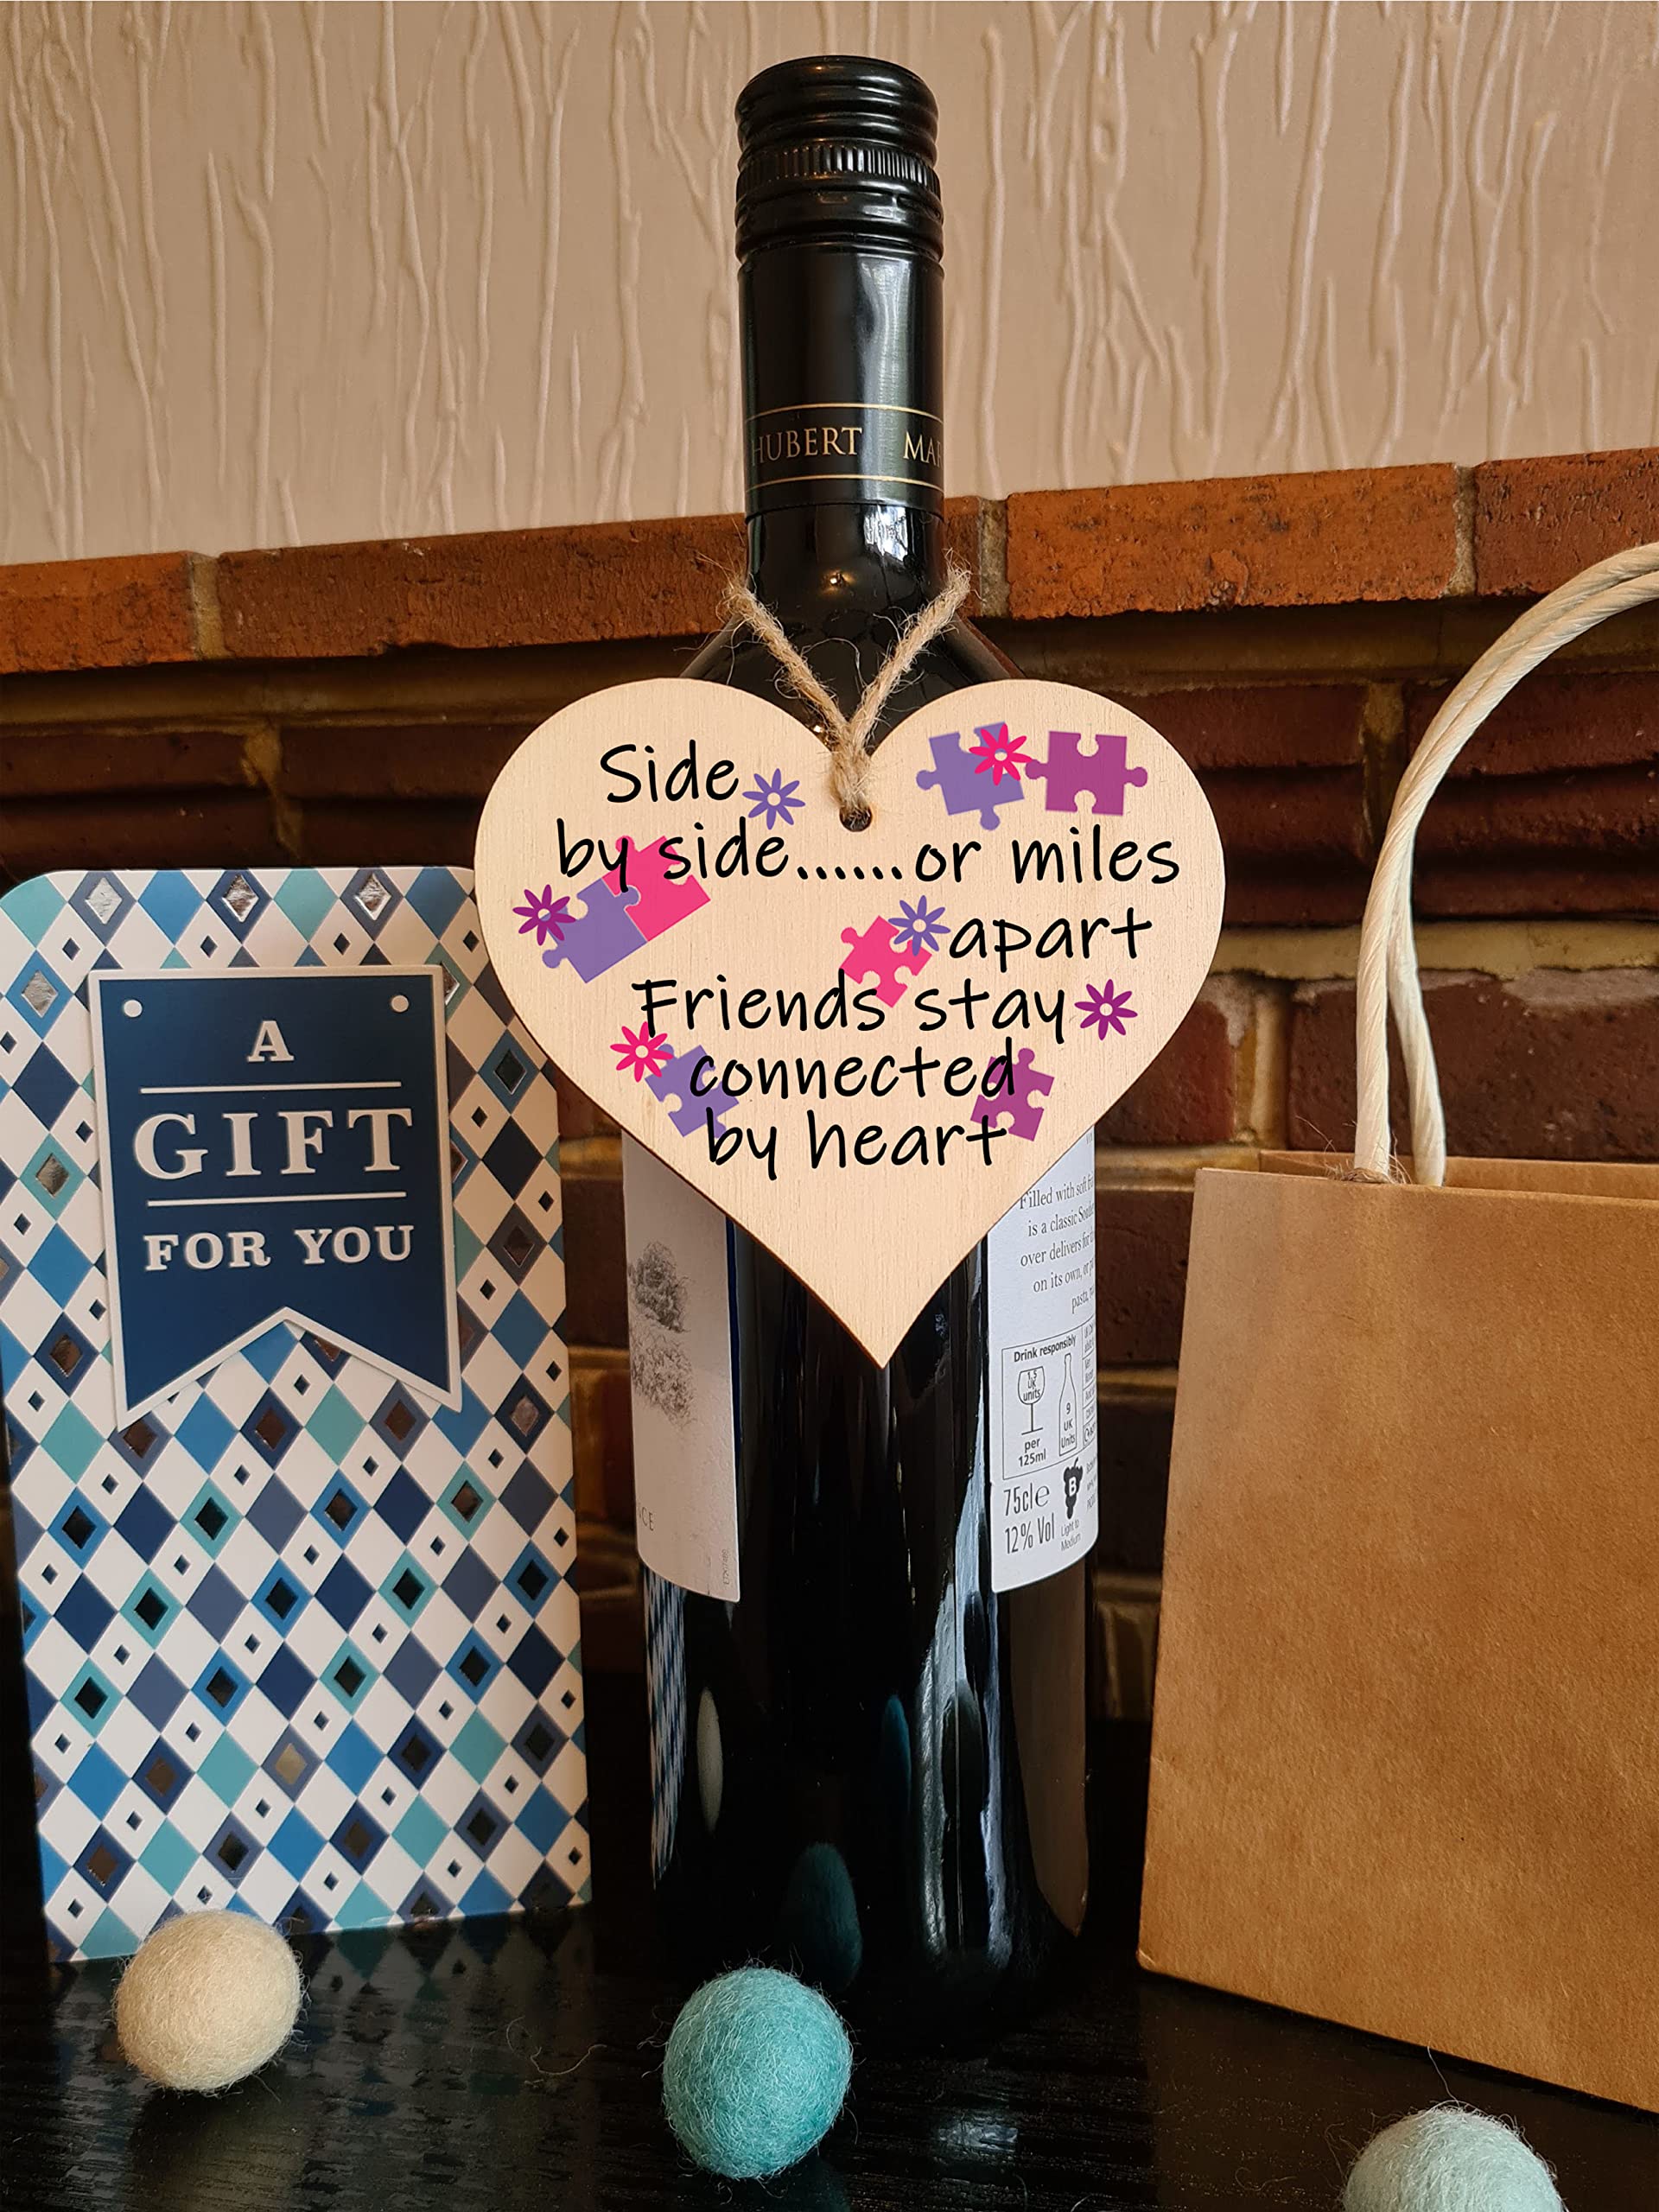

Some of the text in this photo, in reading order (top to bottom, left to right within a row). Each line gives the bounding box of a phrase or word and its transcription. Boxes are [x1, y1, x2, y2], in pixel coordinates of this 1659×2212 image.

[752, 427, 862, 467] HUBERT
[601, 740, 739, 803] Side
[557, 818, 629, 893] by
[1013, 823, 1179, 885] miles
[949, 908, 1153, 973] apart
[632, 969, 1065, 1045] Friends stay
[246, 1020, 295, 1063] A
[690, 1037, 1015, 1101] connected
[134, 1108, 413, 1179] GIFT
[705, 1107, 1007, 1181] by heart
[1056, 1182, 1075, 1202] with
[1028, 1219, 1038, 1236] is
[1041, 1223, 1047, 1234] a
[1050, 1210, 1077, 1232] classic
[143, 1225, 414, 1271] FOR YOU
[1020, 1250, 1046, 1267] over
[1049, 1240, 1082, 1261] delivers
[1033, 1279, 1047, 1293] on
[1051, 1271, 1063, 1288] its
[1014, 1347, 1037, 1363] Drink
[1039, 1334, 1077, 1356] responsibly
[1023, 1389, 1041, 1401] units
[1027, 1377, 1037, 1389] UK
[1065, 1402, 1071, 1414] 9
[1064, 1419, 1073, 1431] UK
[1025, 1438, 1040, 1453] per
[1061, 1433, 1076, 1448] Units
[1018, 1448, 1046, 1467] 125ml
[1069, 1476, 1077, 1497] B
[1005, 1512, 1054, 1554] 12% Vol
